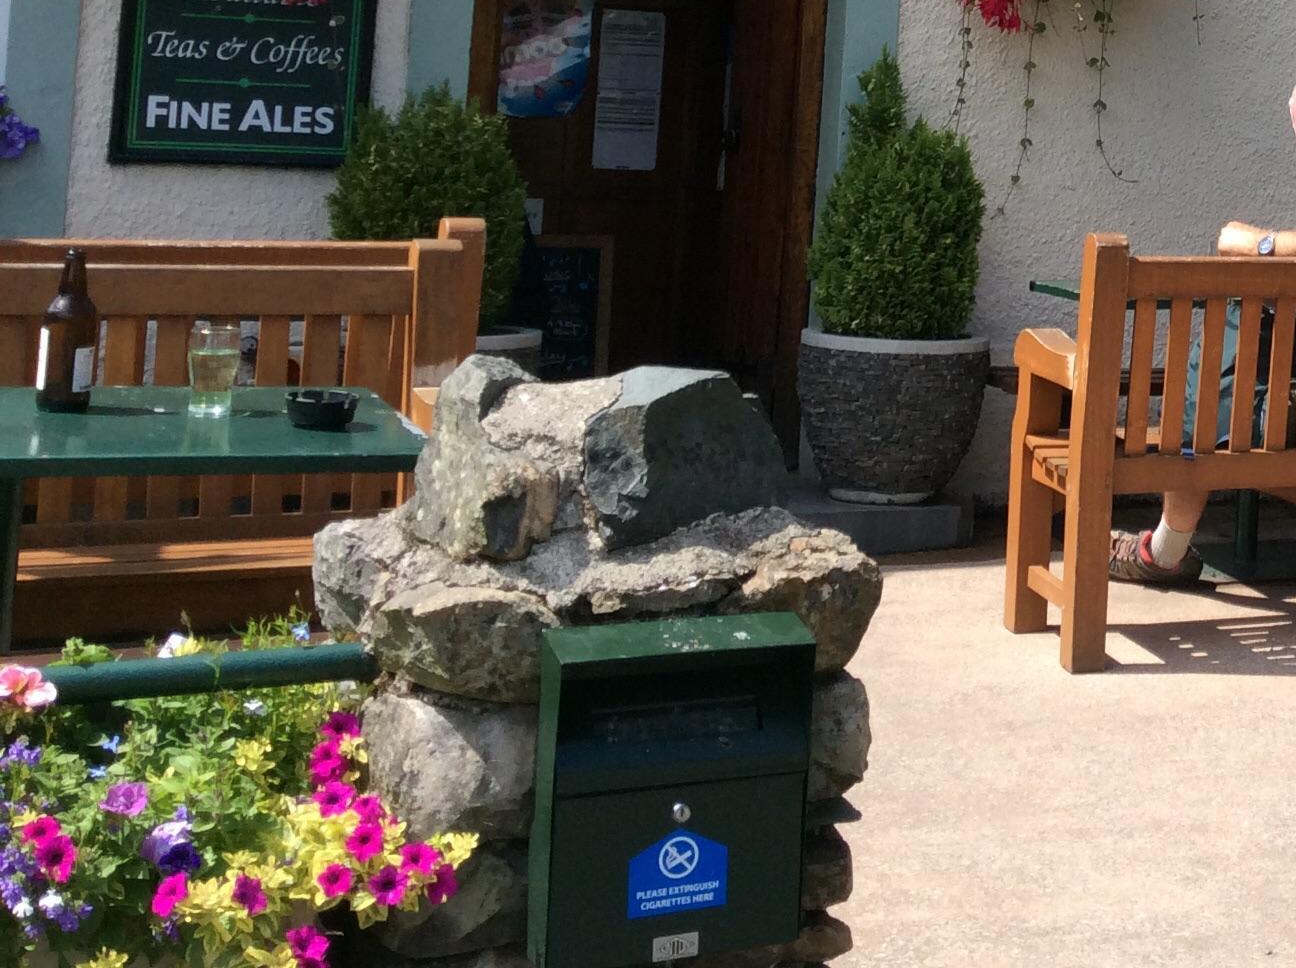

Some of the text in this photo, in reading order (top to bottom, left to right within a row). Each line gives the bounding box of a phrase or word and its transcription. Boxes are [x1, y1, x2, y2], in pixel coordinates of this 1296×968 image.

[147, 30, 344, 73] Teas & Coffees
[145, 94, 336, 135] FINE ALES
[636, 880, 719, 900] PLEASE EXTINGUISH
[640, 892, 715, 911] CIGARETTES HERE
